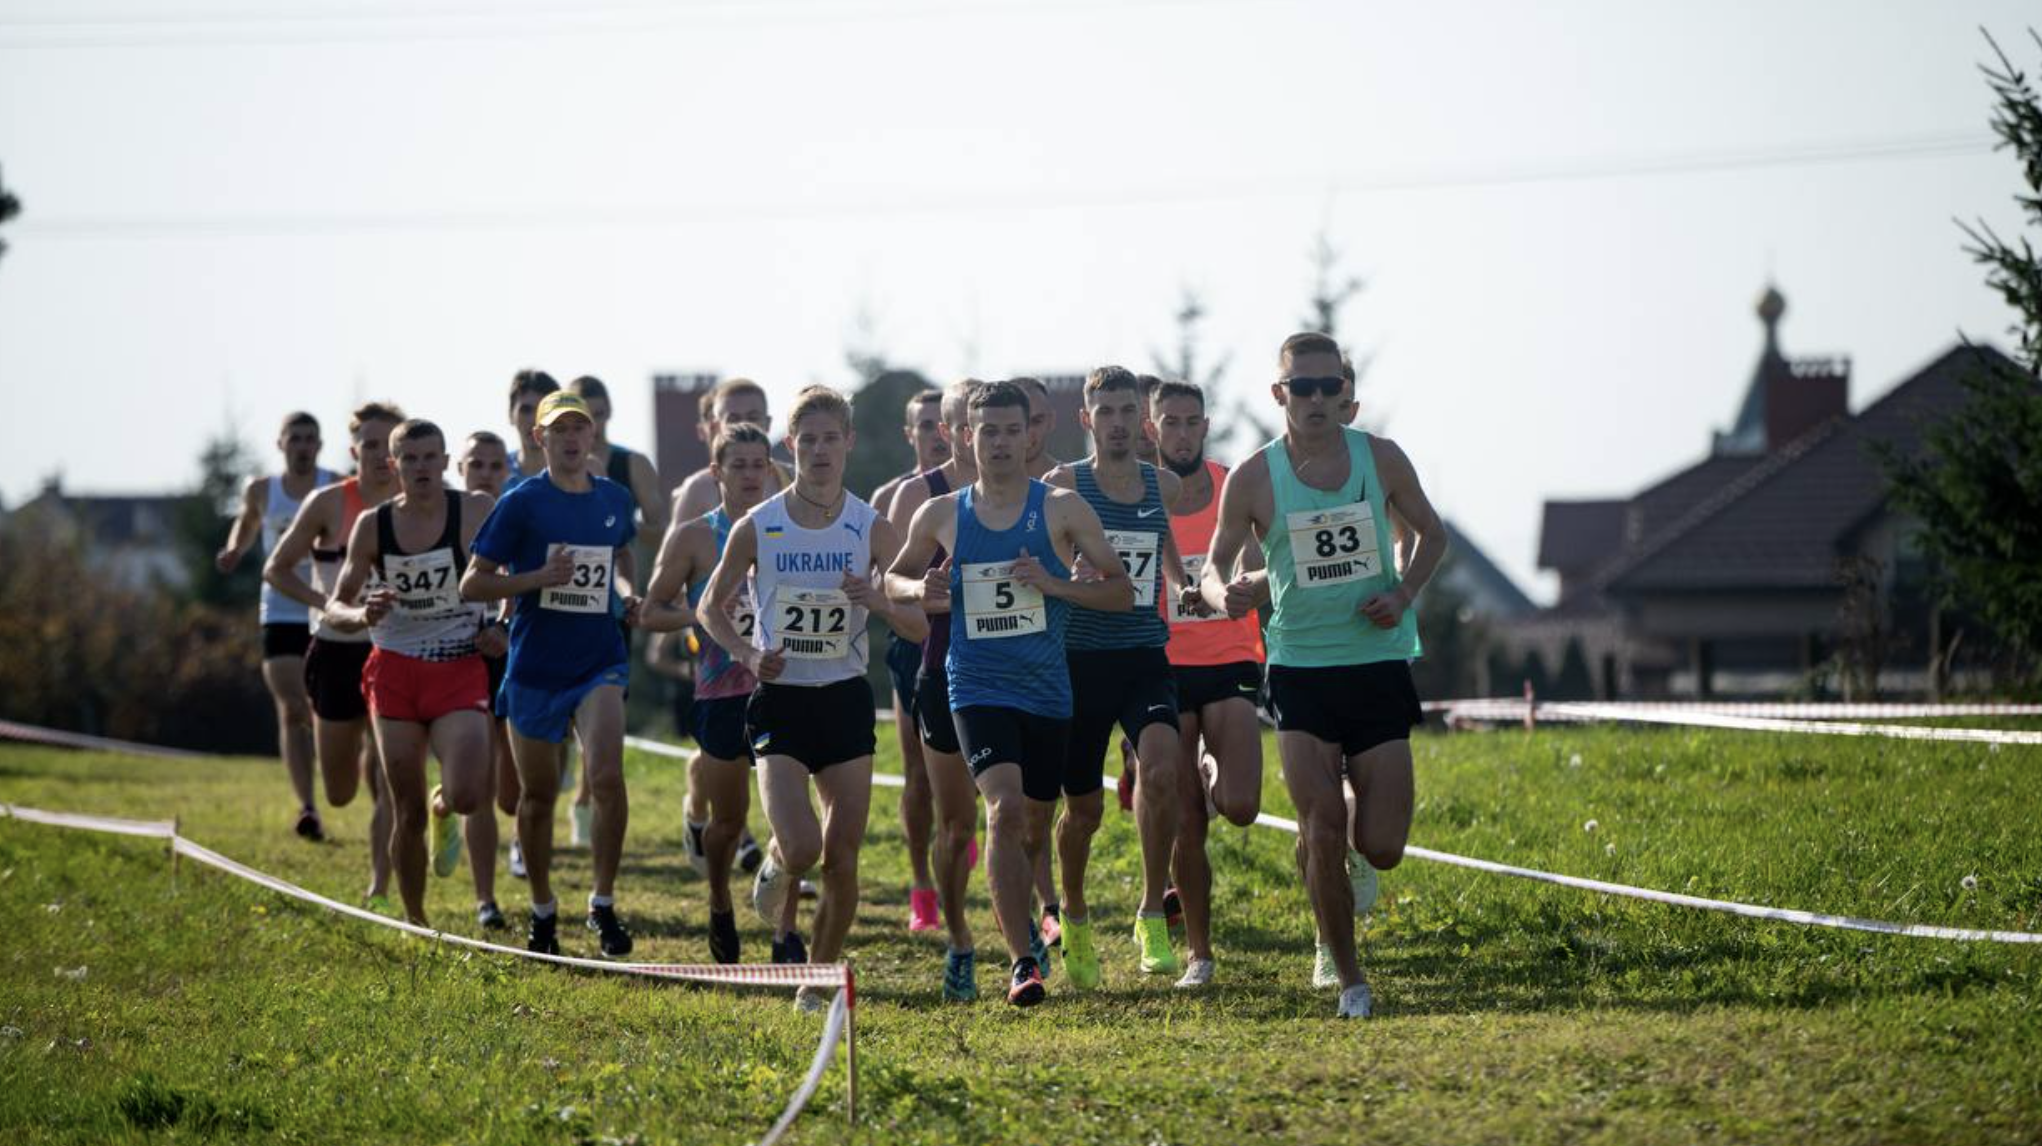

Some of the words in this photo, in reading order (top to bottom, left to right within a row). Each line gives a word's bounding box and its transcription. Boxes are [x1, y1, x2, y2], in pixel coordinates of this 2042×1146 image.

[1315, 525, 1360, 557] 83
[776, 552, 853, 572] UKRAINE
[1306, 560, 1353, 581] PUMA
[396, 566, 451, 592] 347
[550, 592, 588, 607] PUMA
[995, 581, 1015, 609] 5
[783, 605, 845, 633] 212
[976, 615, 1019, 632] PUMA
[783, 637, 824, 653] PUMA
